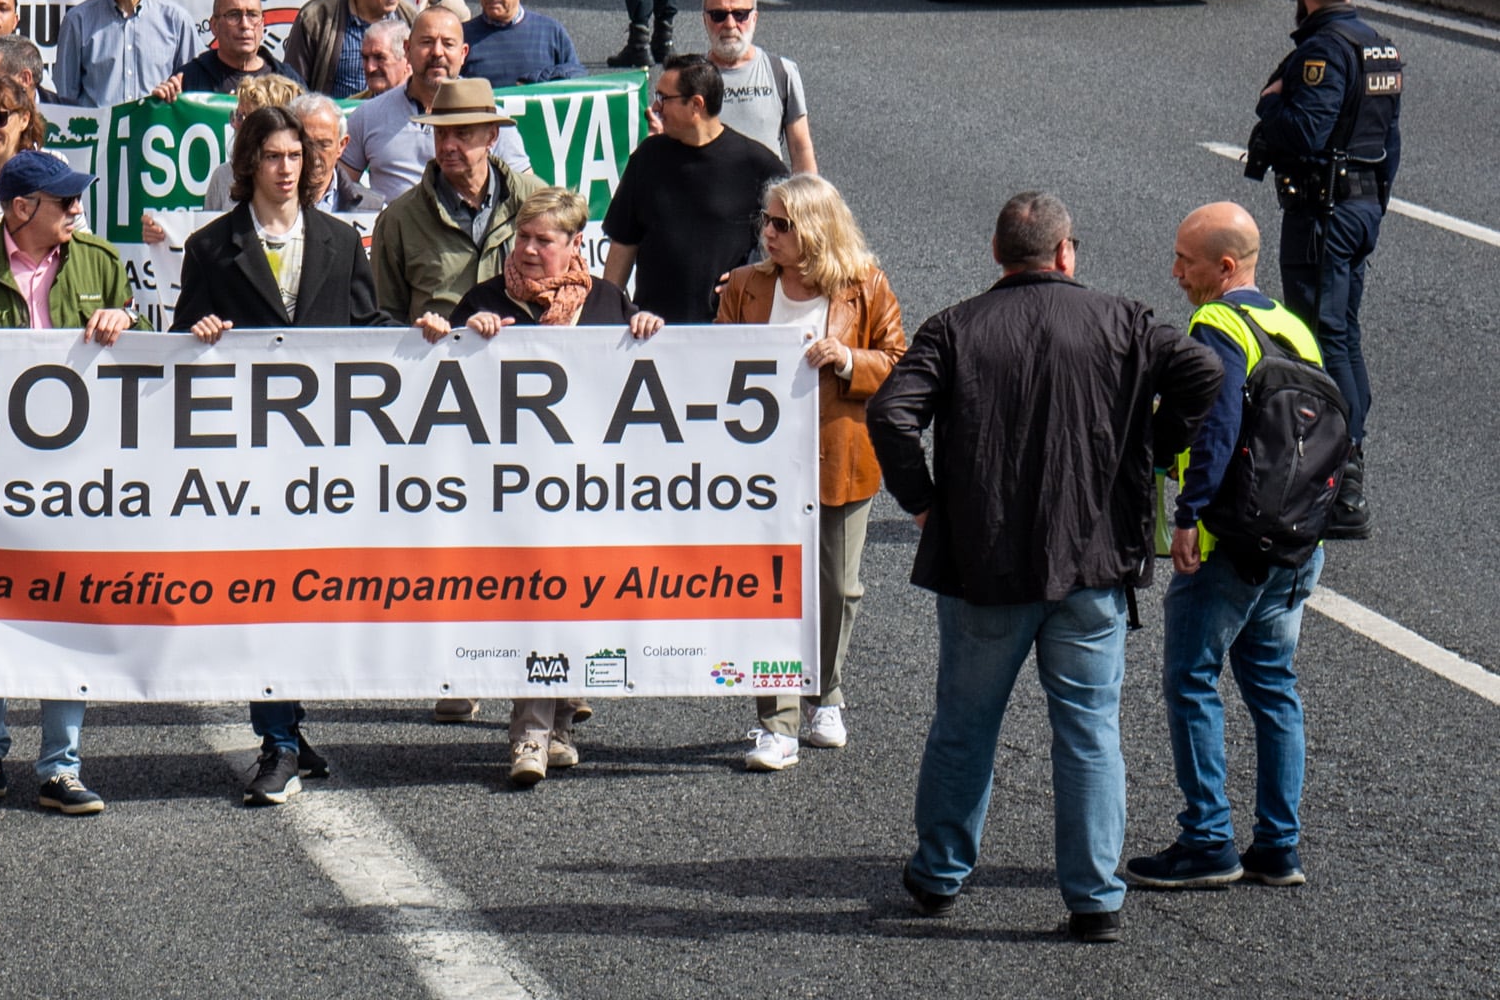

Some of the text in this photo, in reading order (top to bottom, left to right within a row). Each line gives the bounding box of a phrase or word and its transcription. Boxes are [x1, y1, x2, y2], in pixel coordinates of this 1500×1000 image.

[1369, 76, 1397, 91] U.I.P.
[603, 359, 779, 444] A-5
[170, 468, 260, 516] Av.
[285, 467, 355, 515] de
[379, 464, 467, 513] los
[493, 462, 778, 513] Poblados
[27, 571, 66, 603] al
[79, 570, 213, 605] tráfico
[228, 578, 276, 604] en
[291, 568, 567, 610] Campamento
[580, 576, 605, 608] y
[615, 565, 759, 600] Aluche
[455, 647, 521, 661] Organizan:
[643, 645, 707, 658] Colaboran:
[529, 660, 568, 678] AVA
[752, 660, 803, 674] FRAVM
